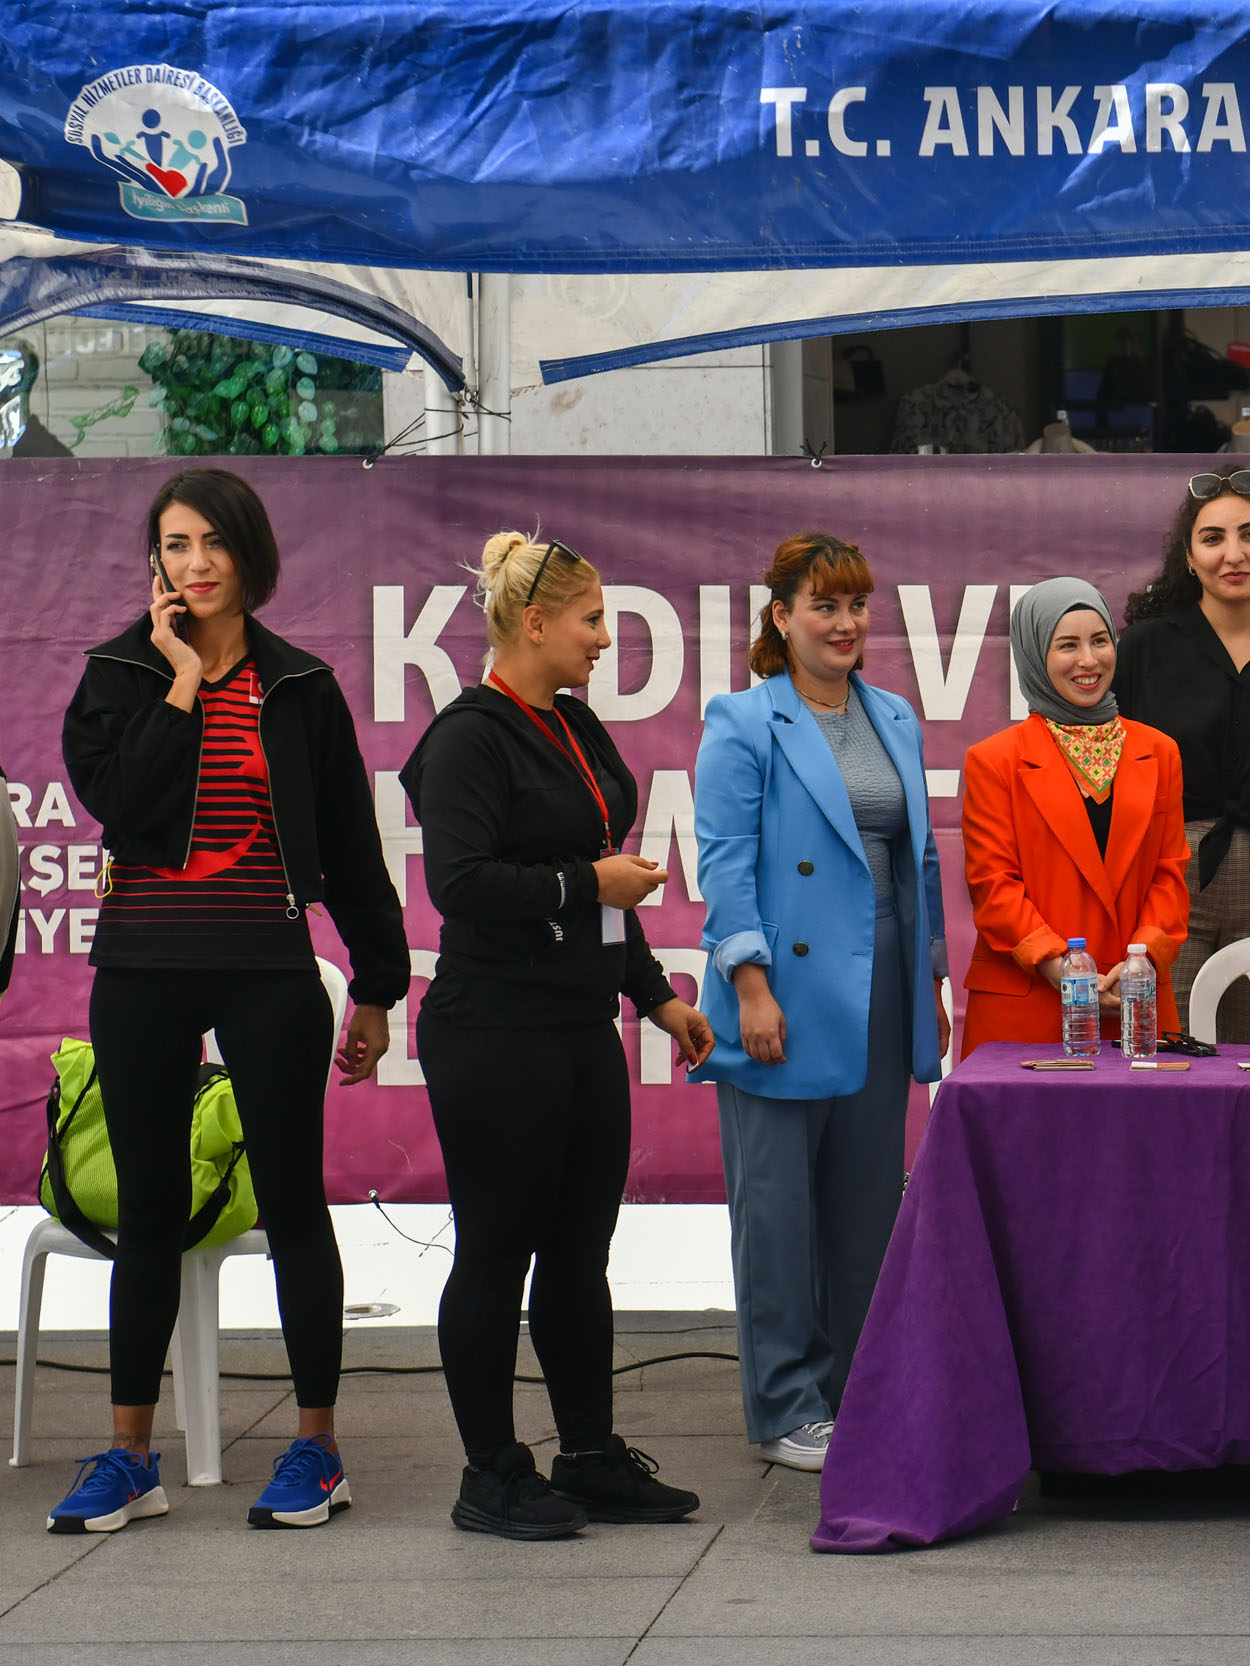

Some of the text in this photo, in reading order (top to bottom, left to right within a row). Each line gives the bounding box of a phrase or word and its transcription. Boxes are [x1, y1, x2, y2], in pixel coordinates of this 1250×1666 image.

[67, 65, 243, 144] SOSYAL HİZMETLER DAİRESİ BAŞKANLIĞI
[760, 86, 891, 157] T.C.
[918, 82, 1247, 156] ANKARA
[373, 585, 776, 722] KDI
